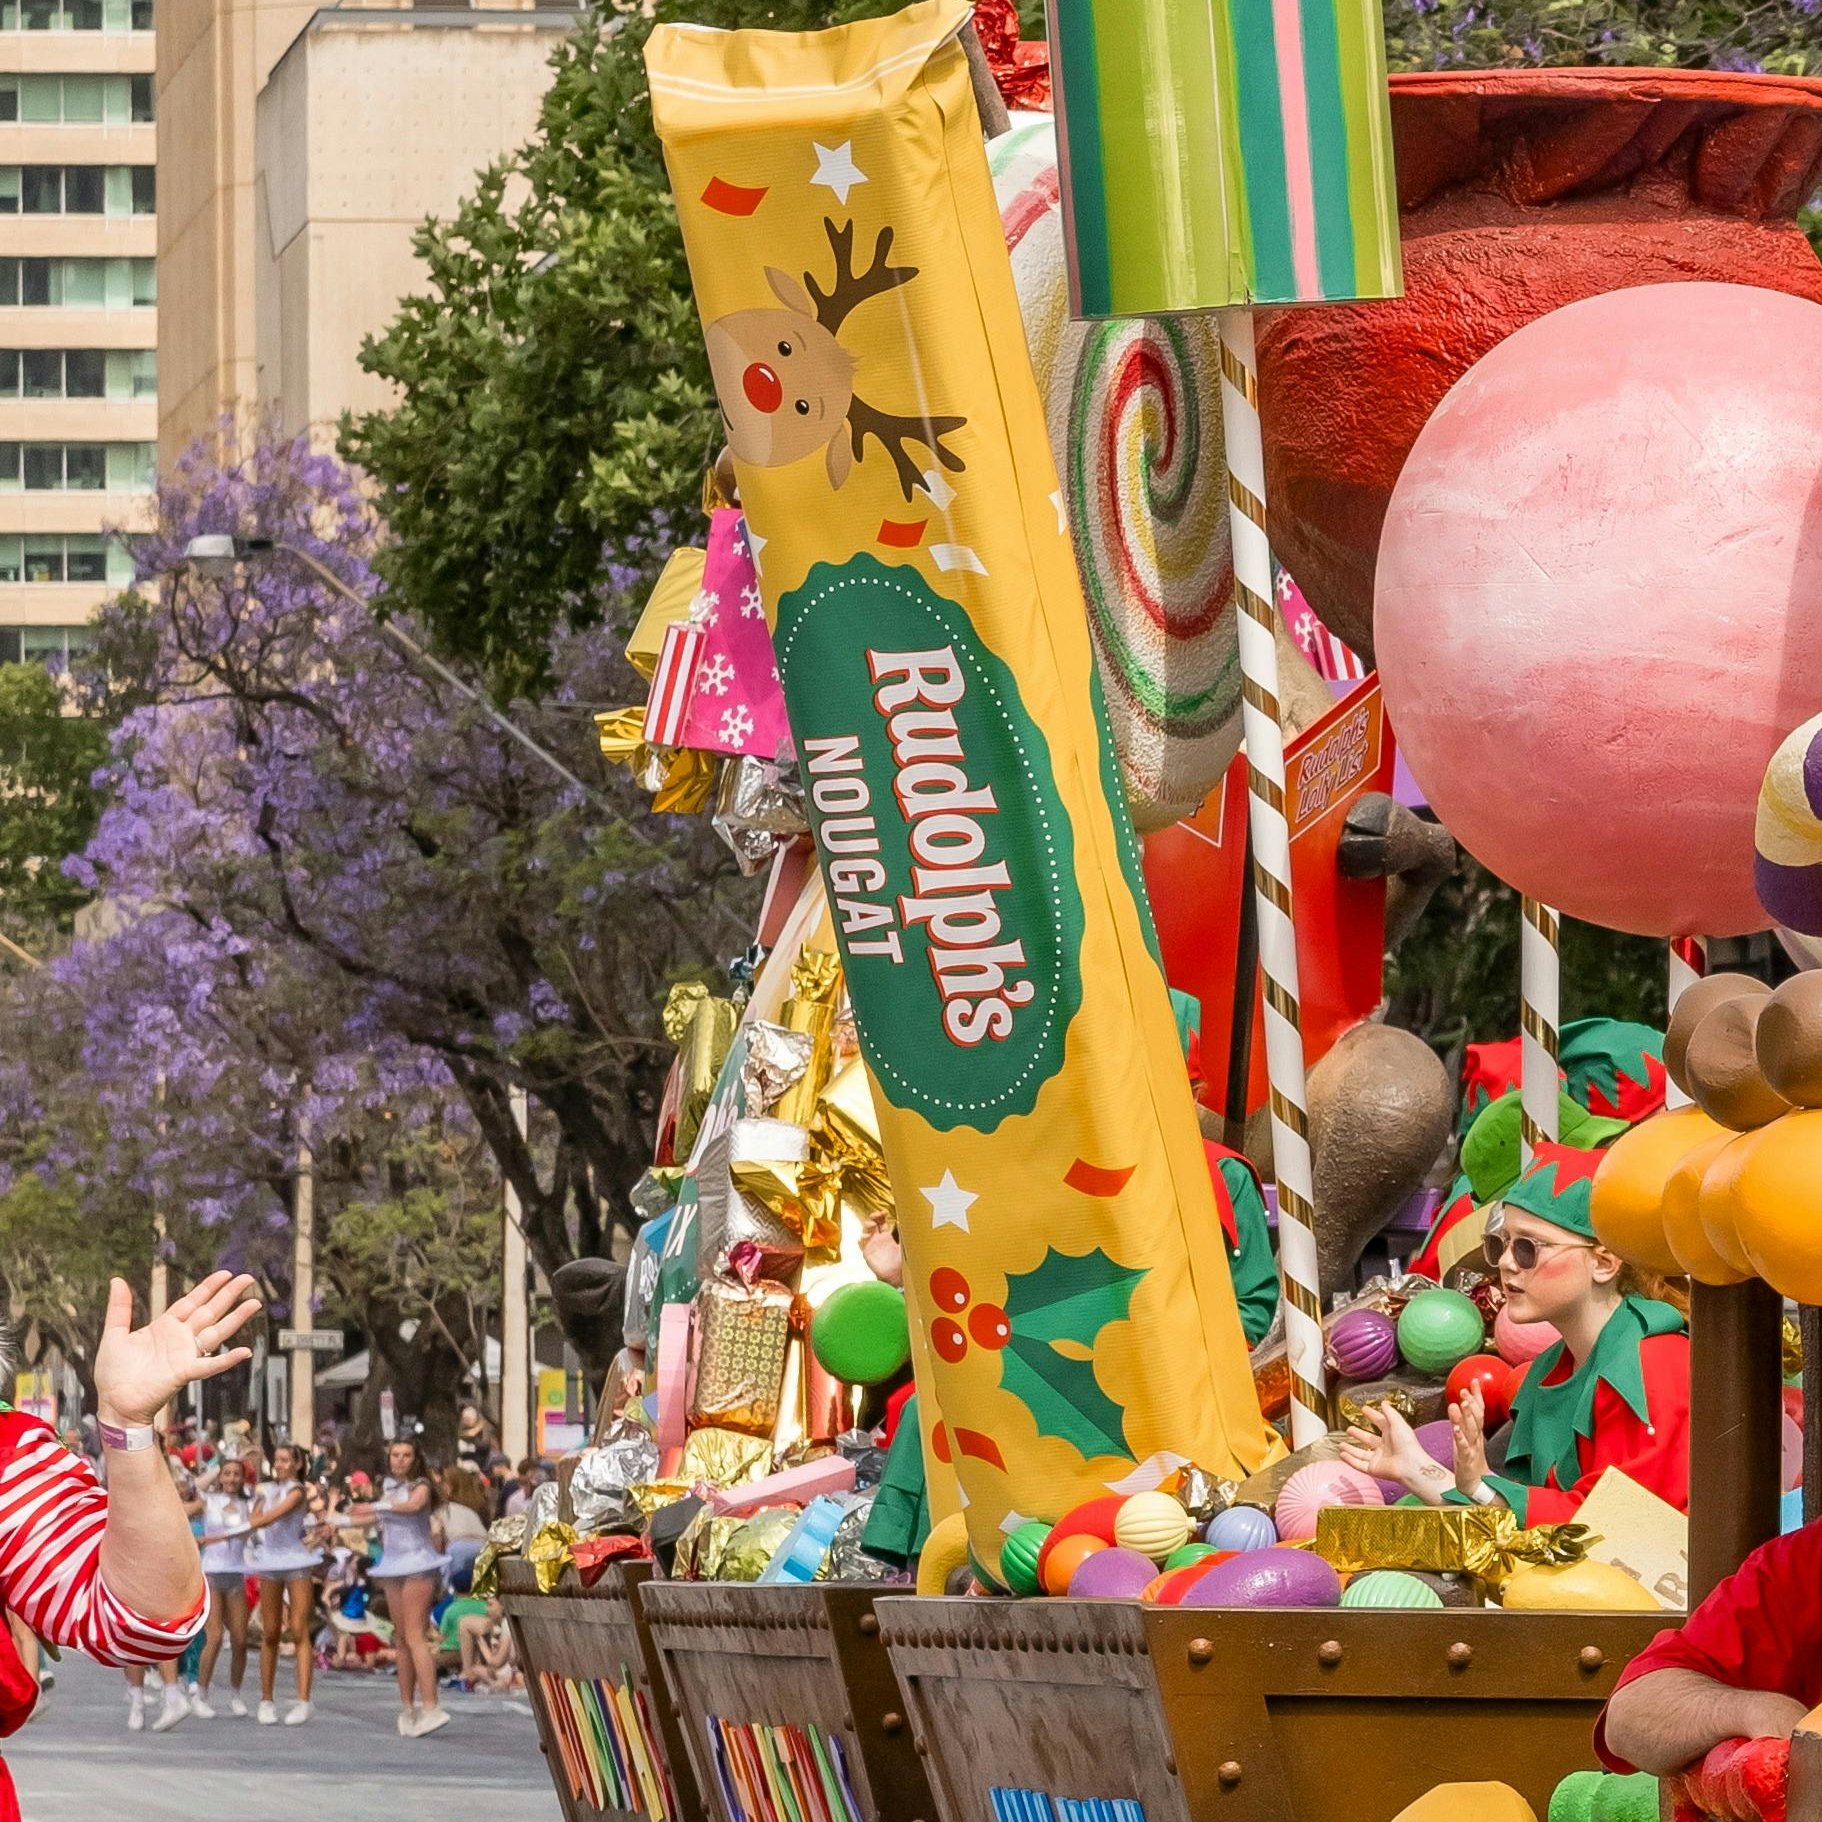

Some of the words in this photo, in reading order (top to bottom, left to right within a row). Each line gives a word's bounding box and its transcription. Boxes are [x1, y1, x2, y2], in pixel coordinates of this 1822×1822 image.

[1295, 769, 1338, 823] Lolly
[1335, 739, 1369, 791] List
[1297, 707, 1370, 790] Rudolph's
[802, 734, 904, 965] NOUGAT
[866, 644, 1035, 1047] Rudolph's
